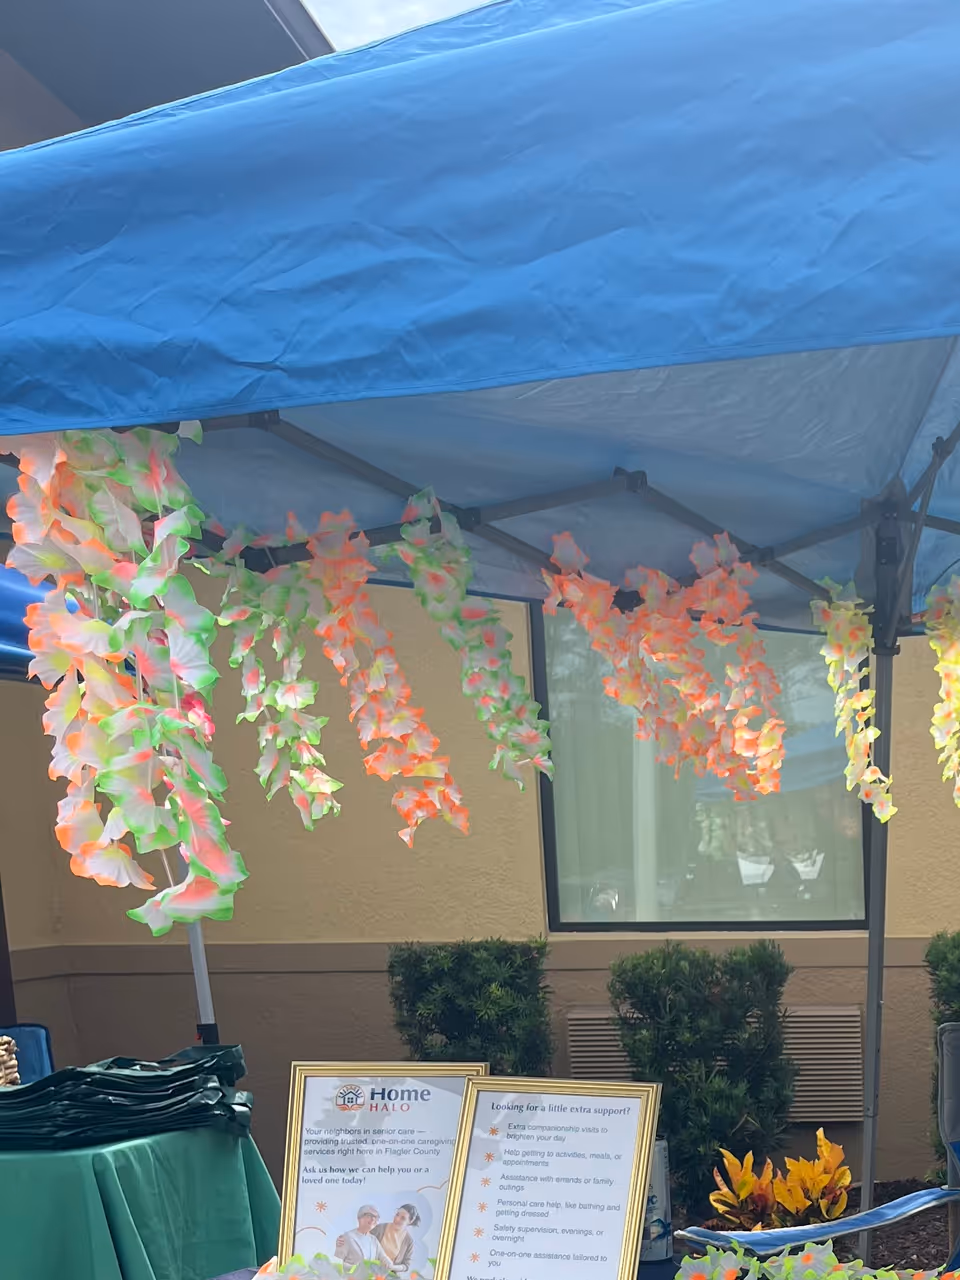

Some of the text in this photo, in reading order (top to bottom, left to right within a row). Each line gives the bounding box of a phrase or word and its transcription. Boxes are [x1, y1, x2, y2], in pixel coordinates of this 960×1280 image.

[370, 1087, 431, 1101] Home
[369, 1103, 410, 1112] HALO
[491, 1102, 524, 1112] Looking
[526, 1103, 539, 1112] for
[548, 1104, 568, 1113] little
[594, 1106, 631, 1116] support?
[305, 1128, 322, 1136] Your
[323, 1128, 361, 1136] neighbors
[527, 1124, 580, 1133] companionship
[506, 1133, 534, 1141] brighten
[304, 1138, 338, 1146] providing
[337, 1148, 354, 1156] right
[385, 1148, 411, 1156] Flagler
[413, 1148, 440, 1157] County
[378, 1166, 395, 1175] help
[342, 1177, 366, 1186] today!
[500, 1174, 538, 1182] Assistance
[593, 1178, 614, 1186] family
[497, 1199, 527, 1207] Personal
[578, 1203, 605, 1211] bathing
[496, 1209, 520, 1218] getting
[494, 1224, 516, 1232] Safety
[561, 1228, 594, 1236] evenings,
[492, 1235, 524, 1243] overnight
[490, 1249, 532, 1259] One-on-one
[534, 1252, 571, 1261] assistance
